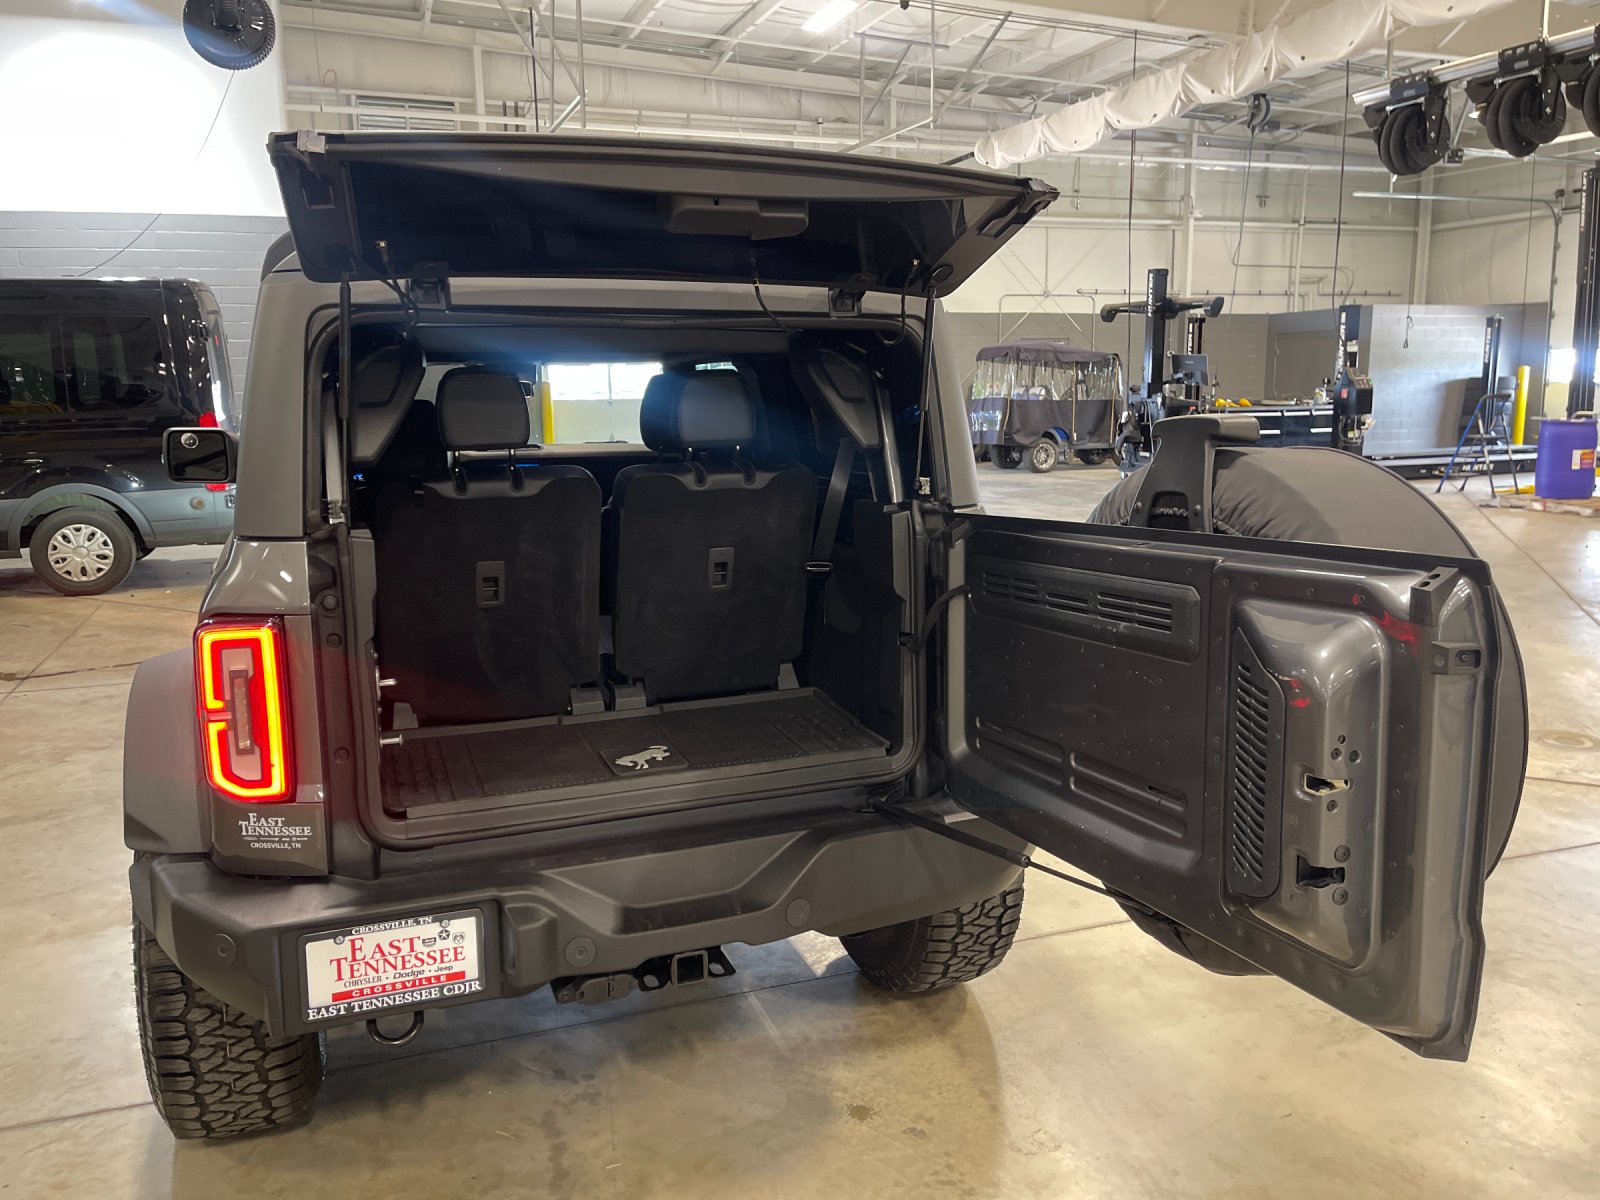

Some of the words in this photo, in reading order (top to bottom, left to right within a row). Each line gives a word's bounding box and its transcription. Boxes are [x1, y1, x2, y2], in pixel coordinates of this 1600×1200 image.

[238, 820, 313, 836] TENNESSEE
[247, 812, 286, 827] EAST
[250, 842, 292, 851] CROSSVILLE,
[351, 919, 418, 935] CROSSVILLE,
[418, 916, 433, 925] TN
[348, 936, 421, 963] EAST
[329, 946, 466, 982] TENNESSEE
[343, 976, 382, 988] CHRYSLER
[393, 969, 426, 980] Dodge
[434, 964, 454, 973] Jeep
[352, 975, 447, 997] CROSSVILLE
[307, 1004, 348, 1021] EAST
[350, 987, 440, 1013] TENNESSEE
[443, 980, 482, 996] CDJR
